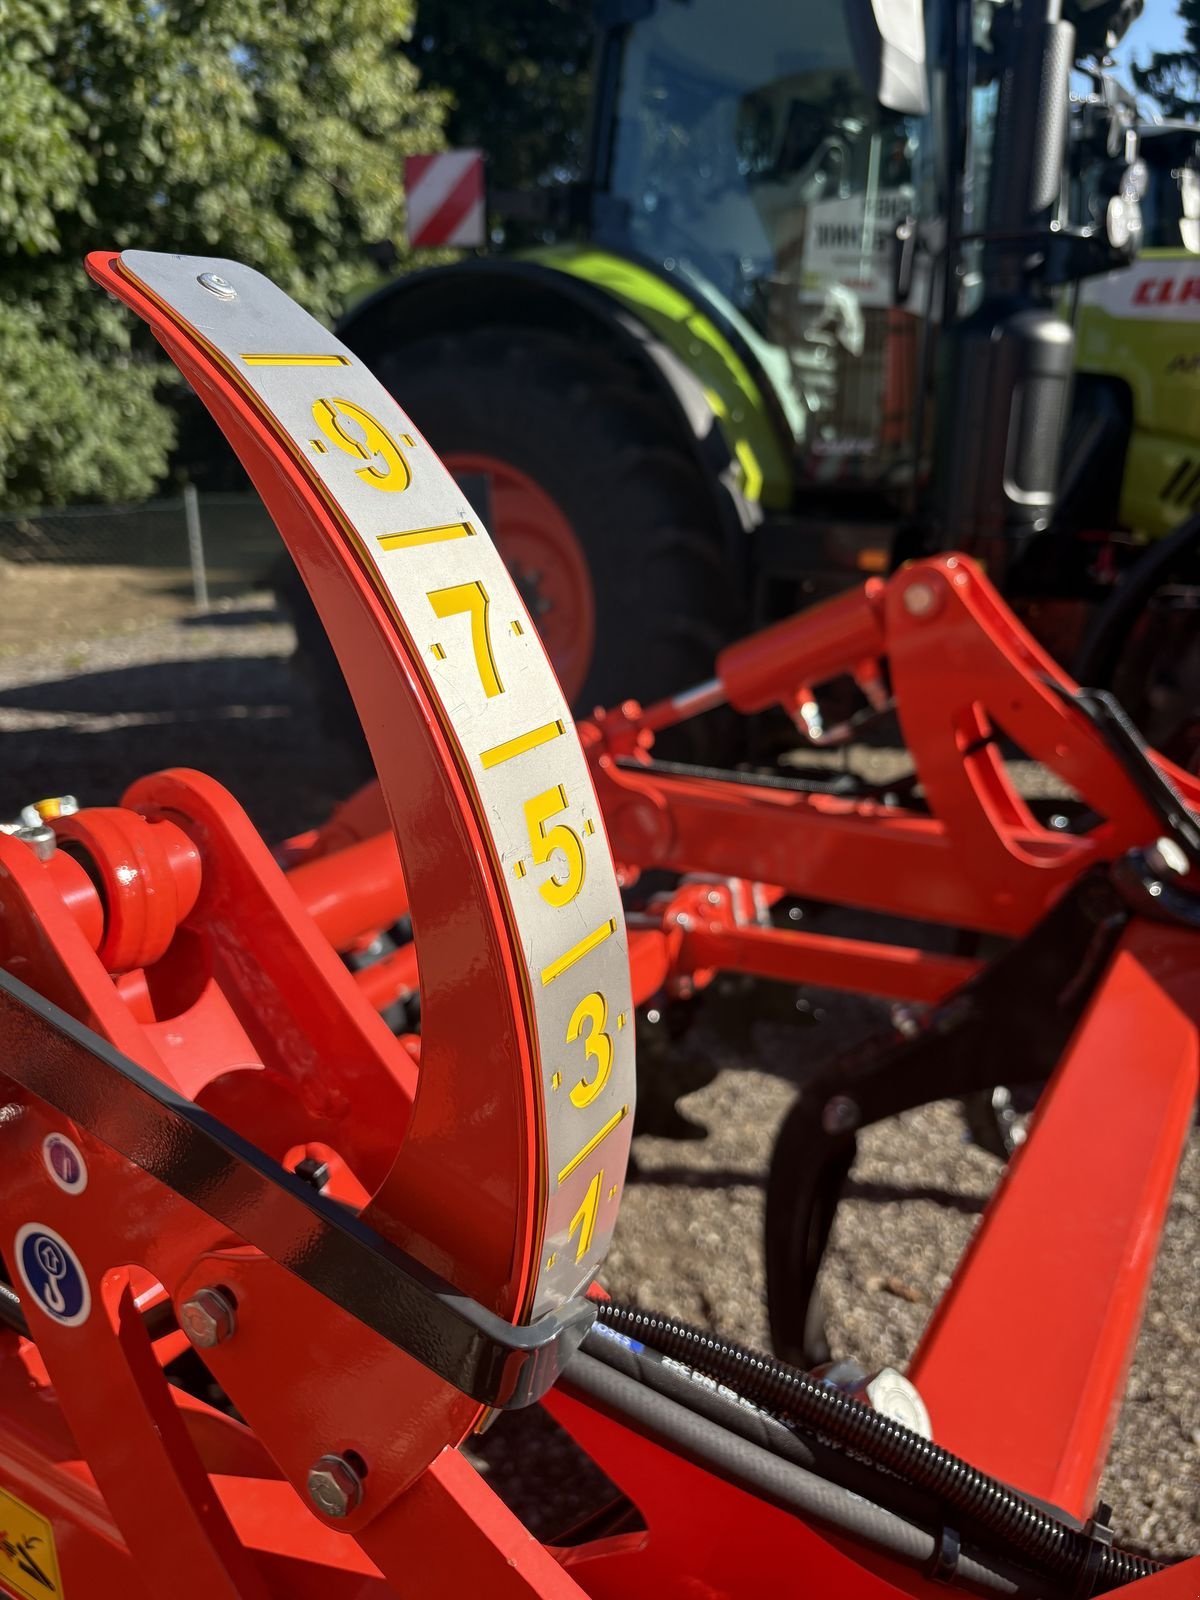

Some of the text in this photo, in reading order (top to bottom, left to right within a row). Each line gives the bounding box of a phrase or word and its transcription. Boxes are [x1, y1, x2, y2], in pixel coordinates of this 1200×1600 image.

[311, 398, 413, 493] 9
[426, 581, 505, 698] 7
[524, 783, 586, 908] 5
[565, 991, 615, 1109] 3
[568, 1168, 604, 1265] 1
